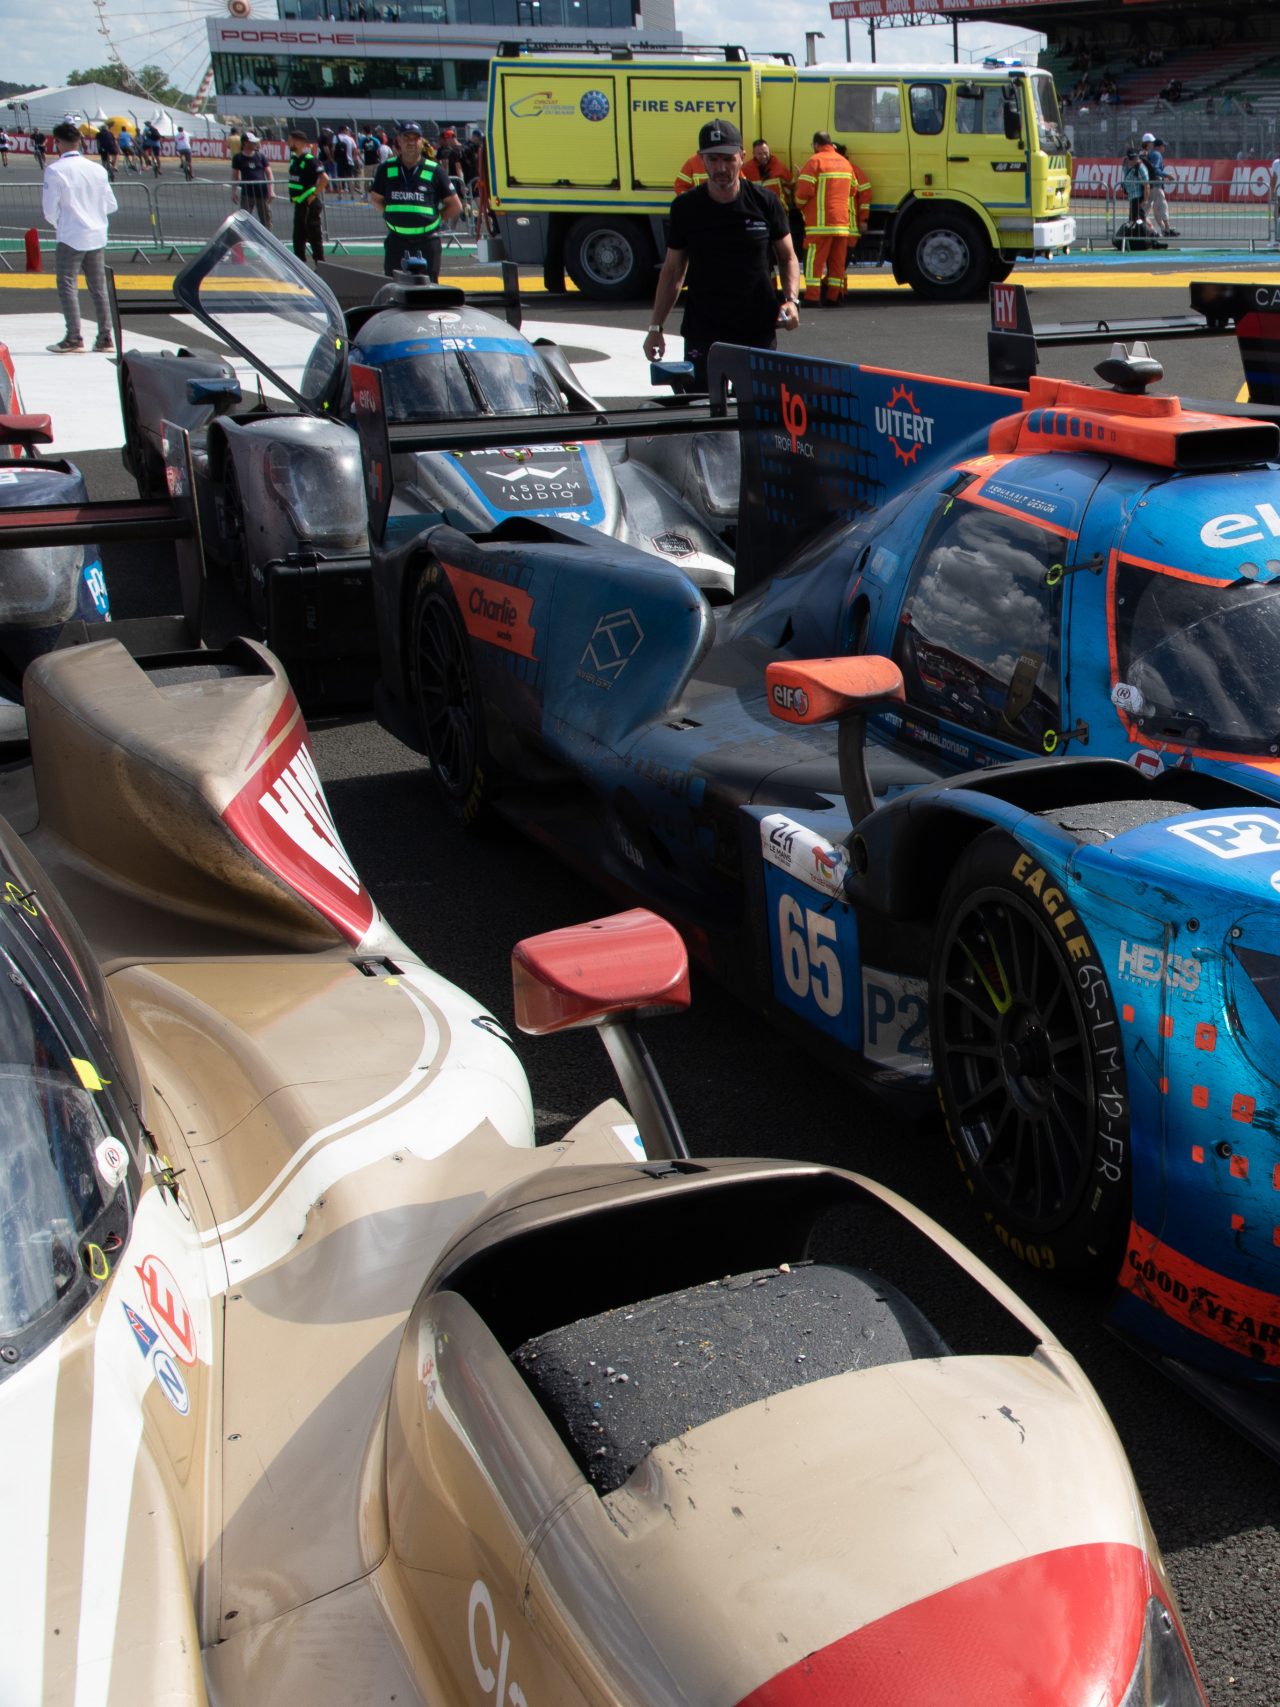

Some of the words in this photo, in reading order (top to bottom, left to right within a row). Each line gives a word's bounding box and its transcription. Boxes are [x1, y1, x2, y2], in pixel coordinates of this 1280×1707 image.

[221, 30, 355, 45] PORSCHE
[632, 99, 670, 113] FIRE
[674, 100, 737, 115] SAFETY
[994, 289, 1017, 328] HY
[875, 406, 935, 445] UITERT
[469, 588, 517, 627] Charlie
[773, 684, 794, 709] elf
[1010, 853, 1092, 963] EAGLE
[778, 893, 844, 1018] 65
[866, 982, 929, 1059] P2
